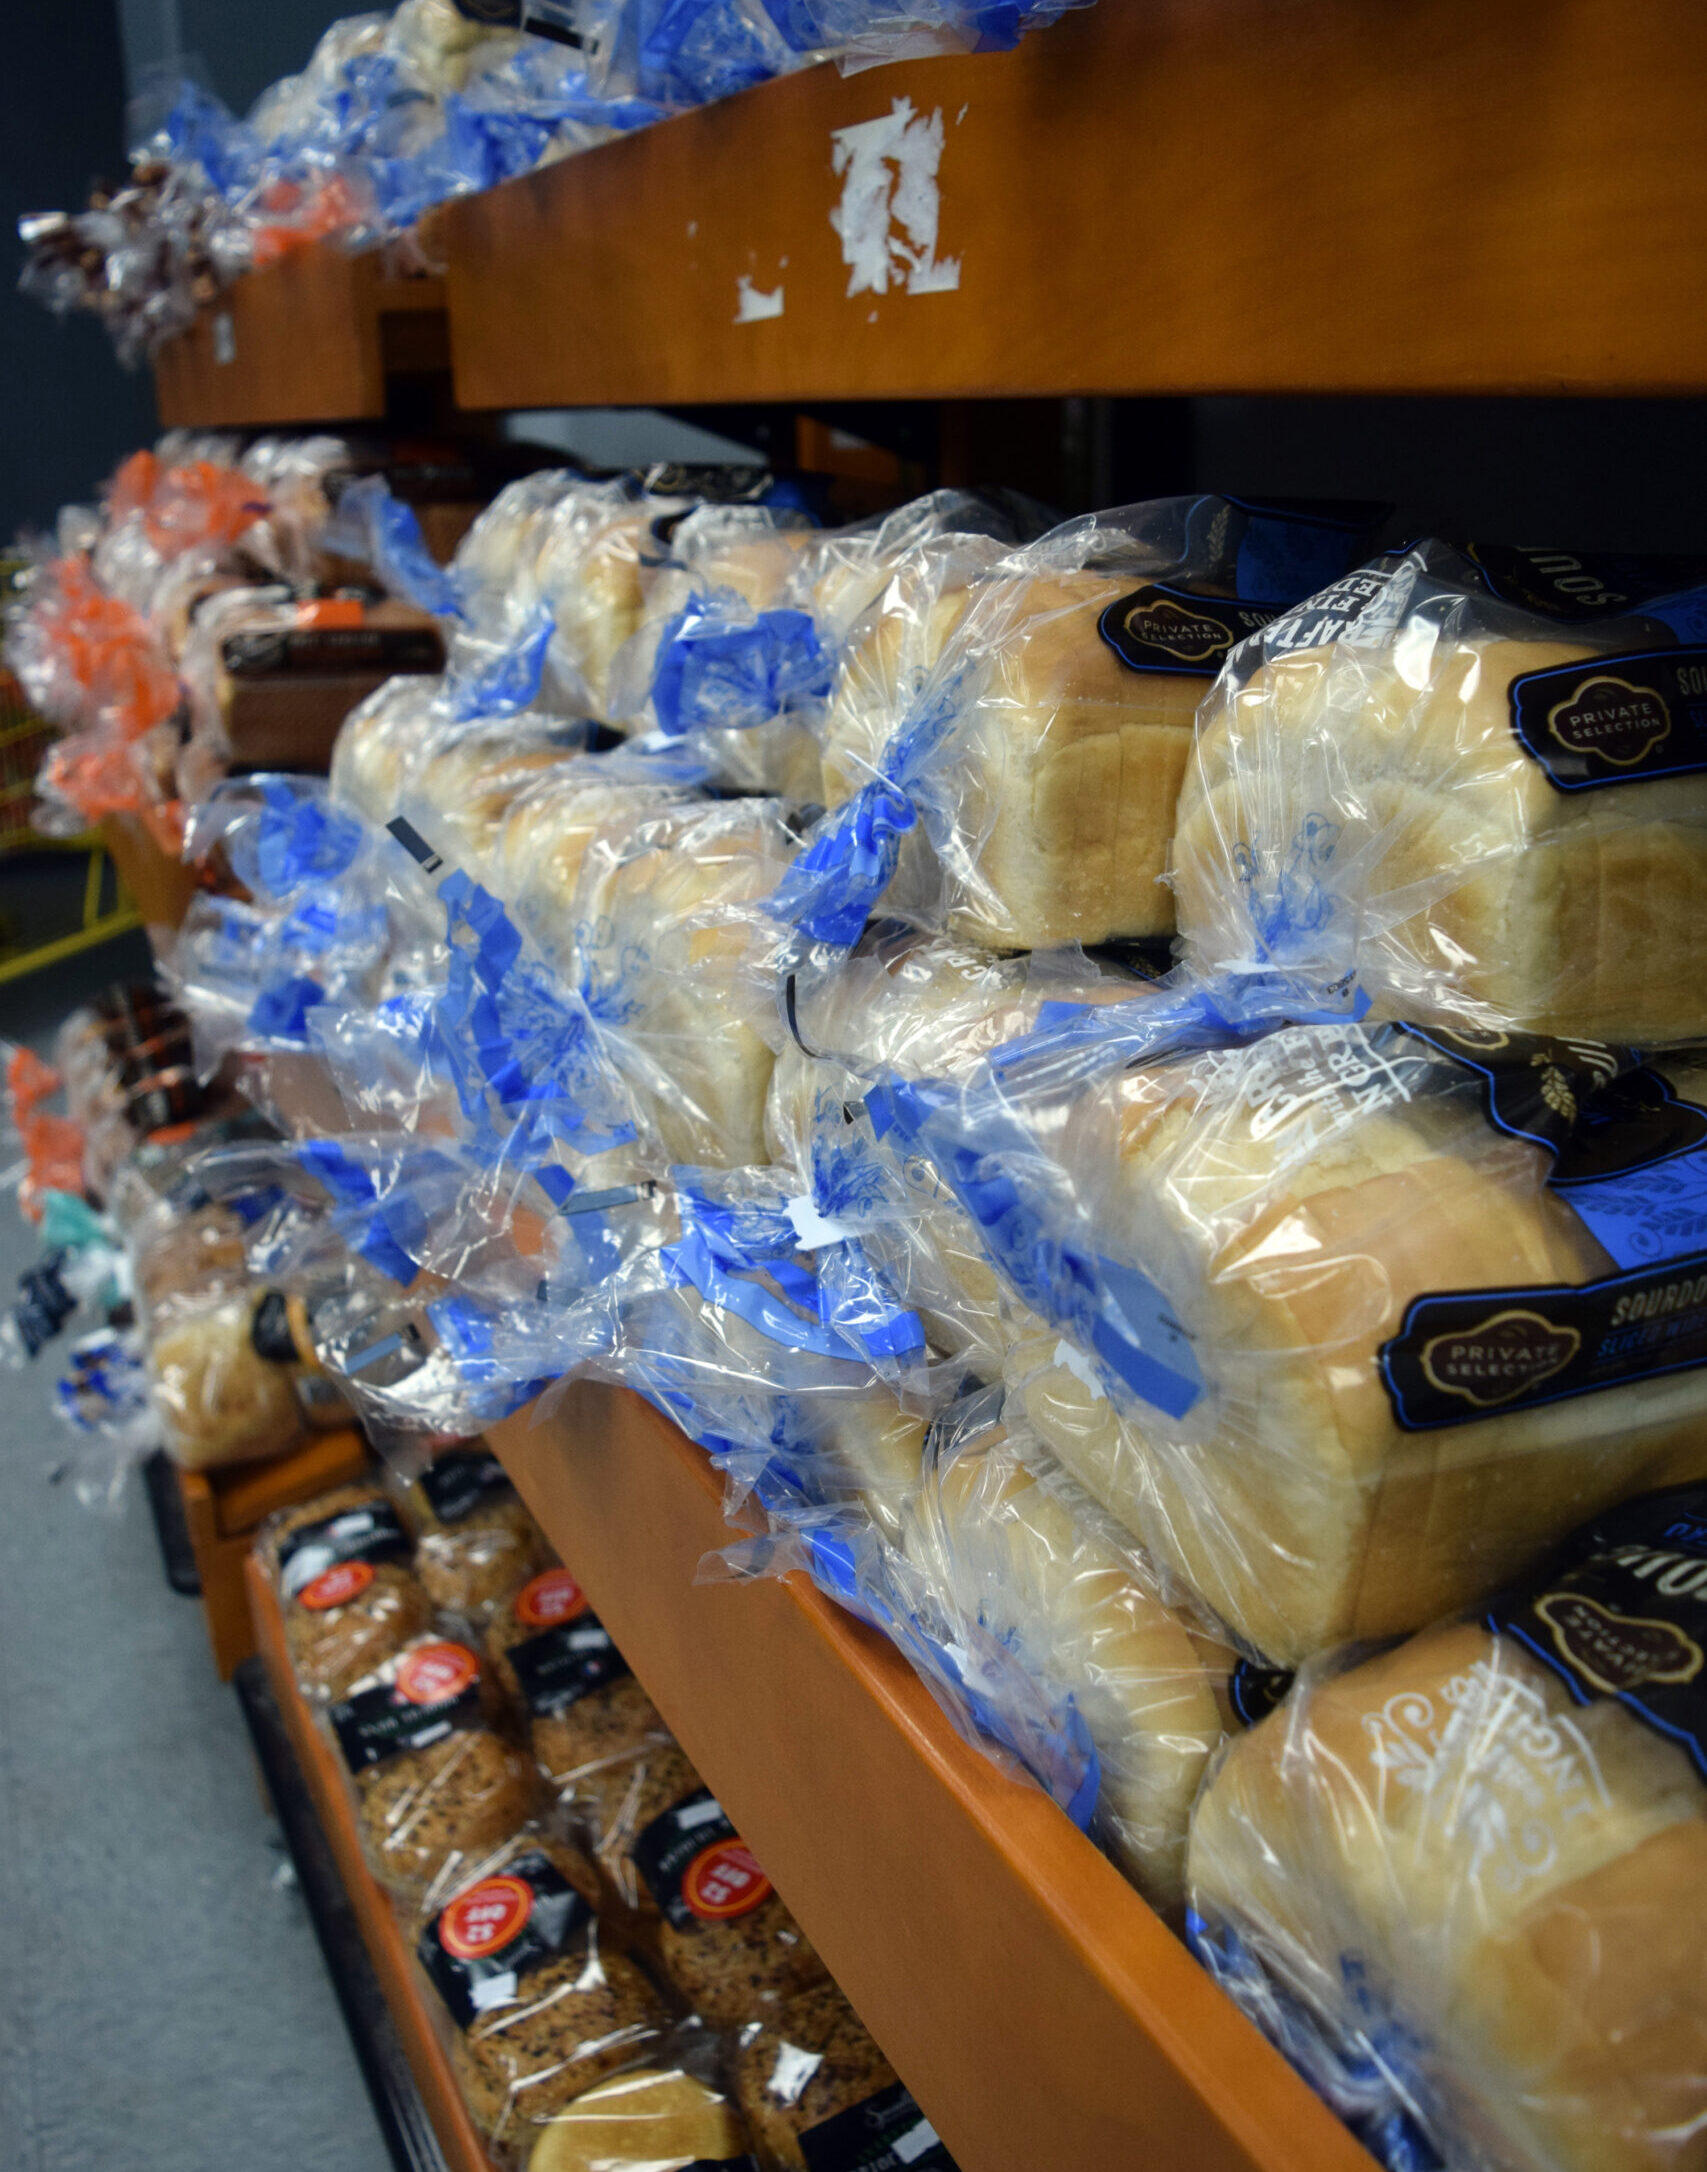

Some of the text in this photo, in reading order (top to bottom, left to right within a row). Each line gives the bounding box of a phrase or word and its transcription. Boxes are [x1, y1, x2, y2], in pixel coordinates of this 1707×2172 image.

[1143, 619, 1213, 634] PRIVATE
[1141, 631, 1222, 641] SELECTION
[1569, 702, 1652, 728] PRIVATE
[1572, 717, 1660, 740] SELECTION
[1450, 1343, 1561, 1361] PRIVATE
